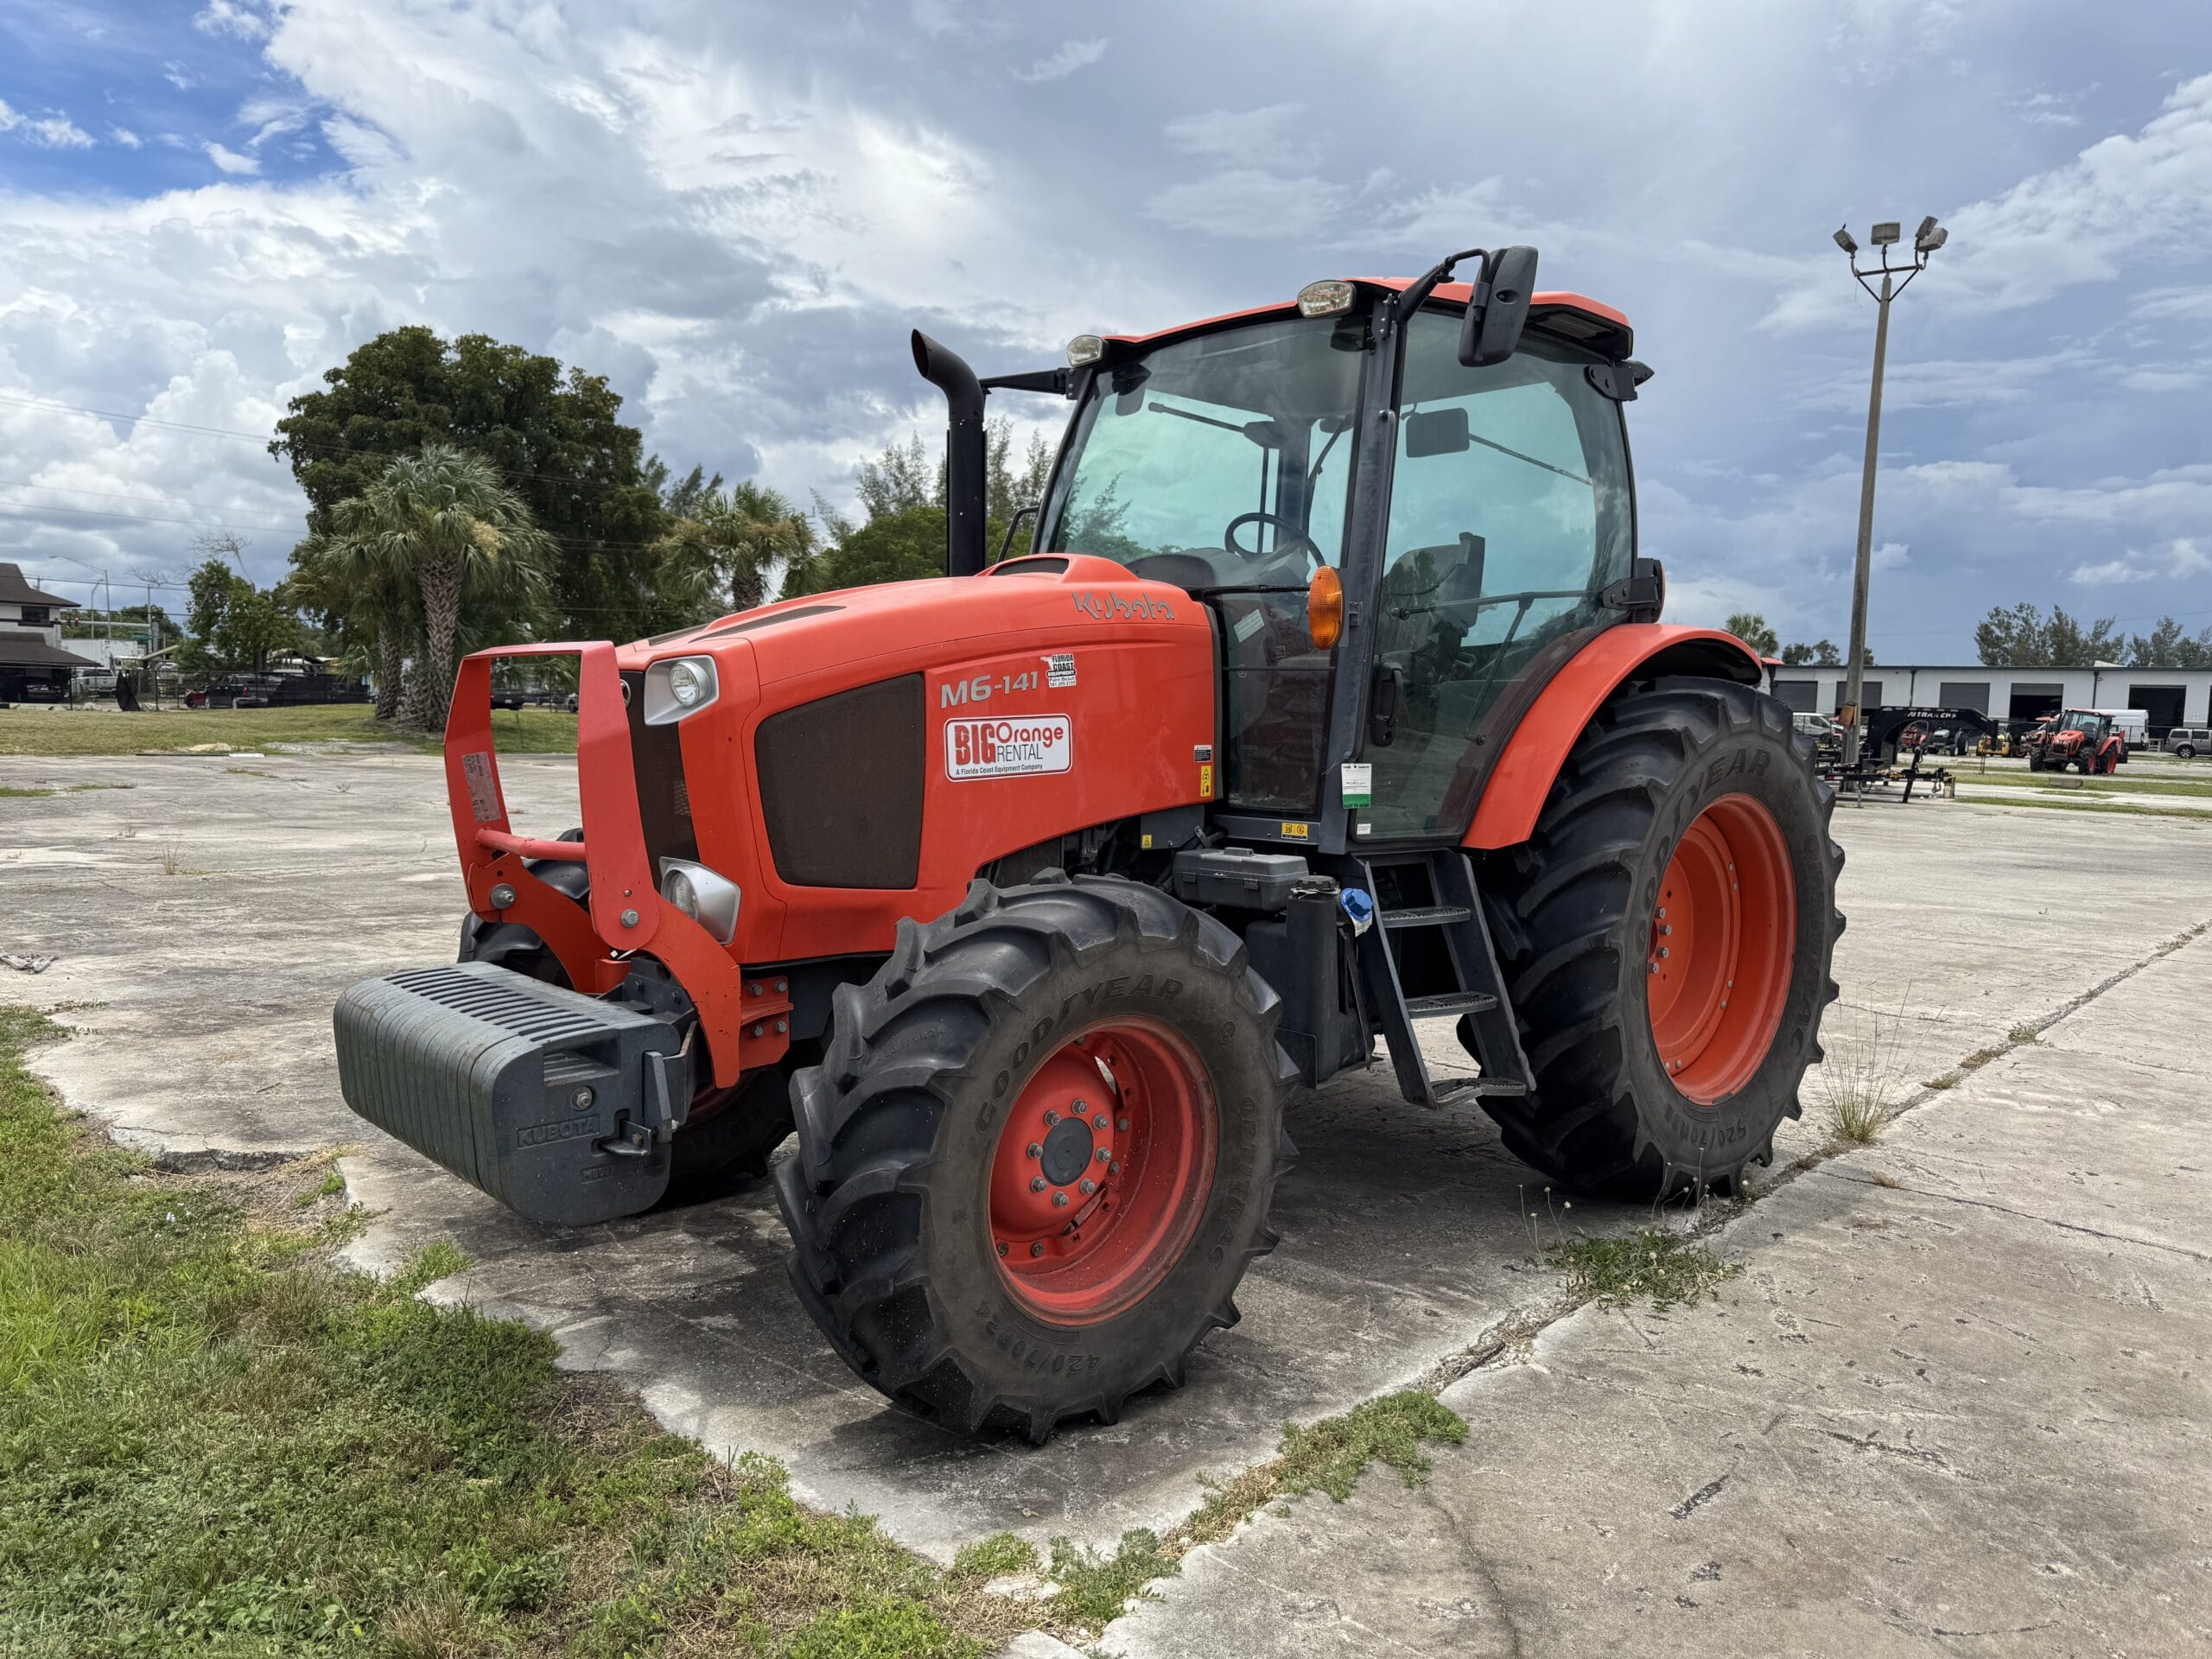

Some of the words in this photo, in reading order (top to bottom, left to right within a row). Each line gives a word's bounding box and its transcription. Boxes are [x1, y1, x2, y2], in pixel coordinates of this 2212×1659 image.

[1071, 591, 1175, 620] Kubota
[941, 671, 1039, 709] M6-141
[954, 722, 996, 766] BIG
[996, 721, 1064, 748] Orange
[997, 744, 1044, 762] RENTAL
[975, 973, 1184, 1135] GOODYEAR
[518, 1116, 594, 1147] KUBOTA
